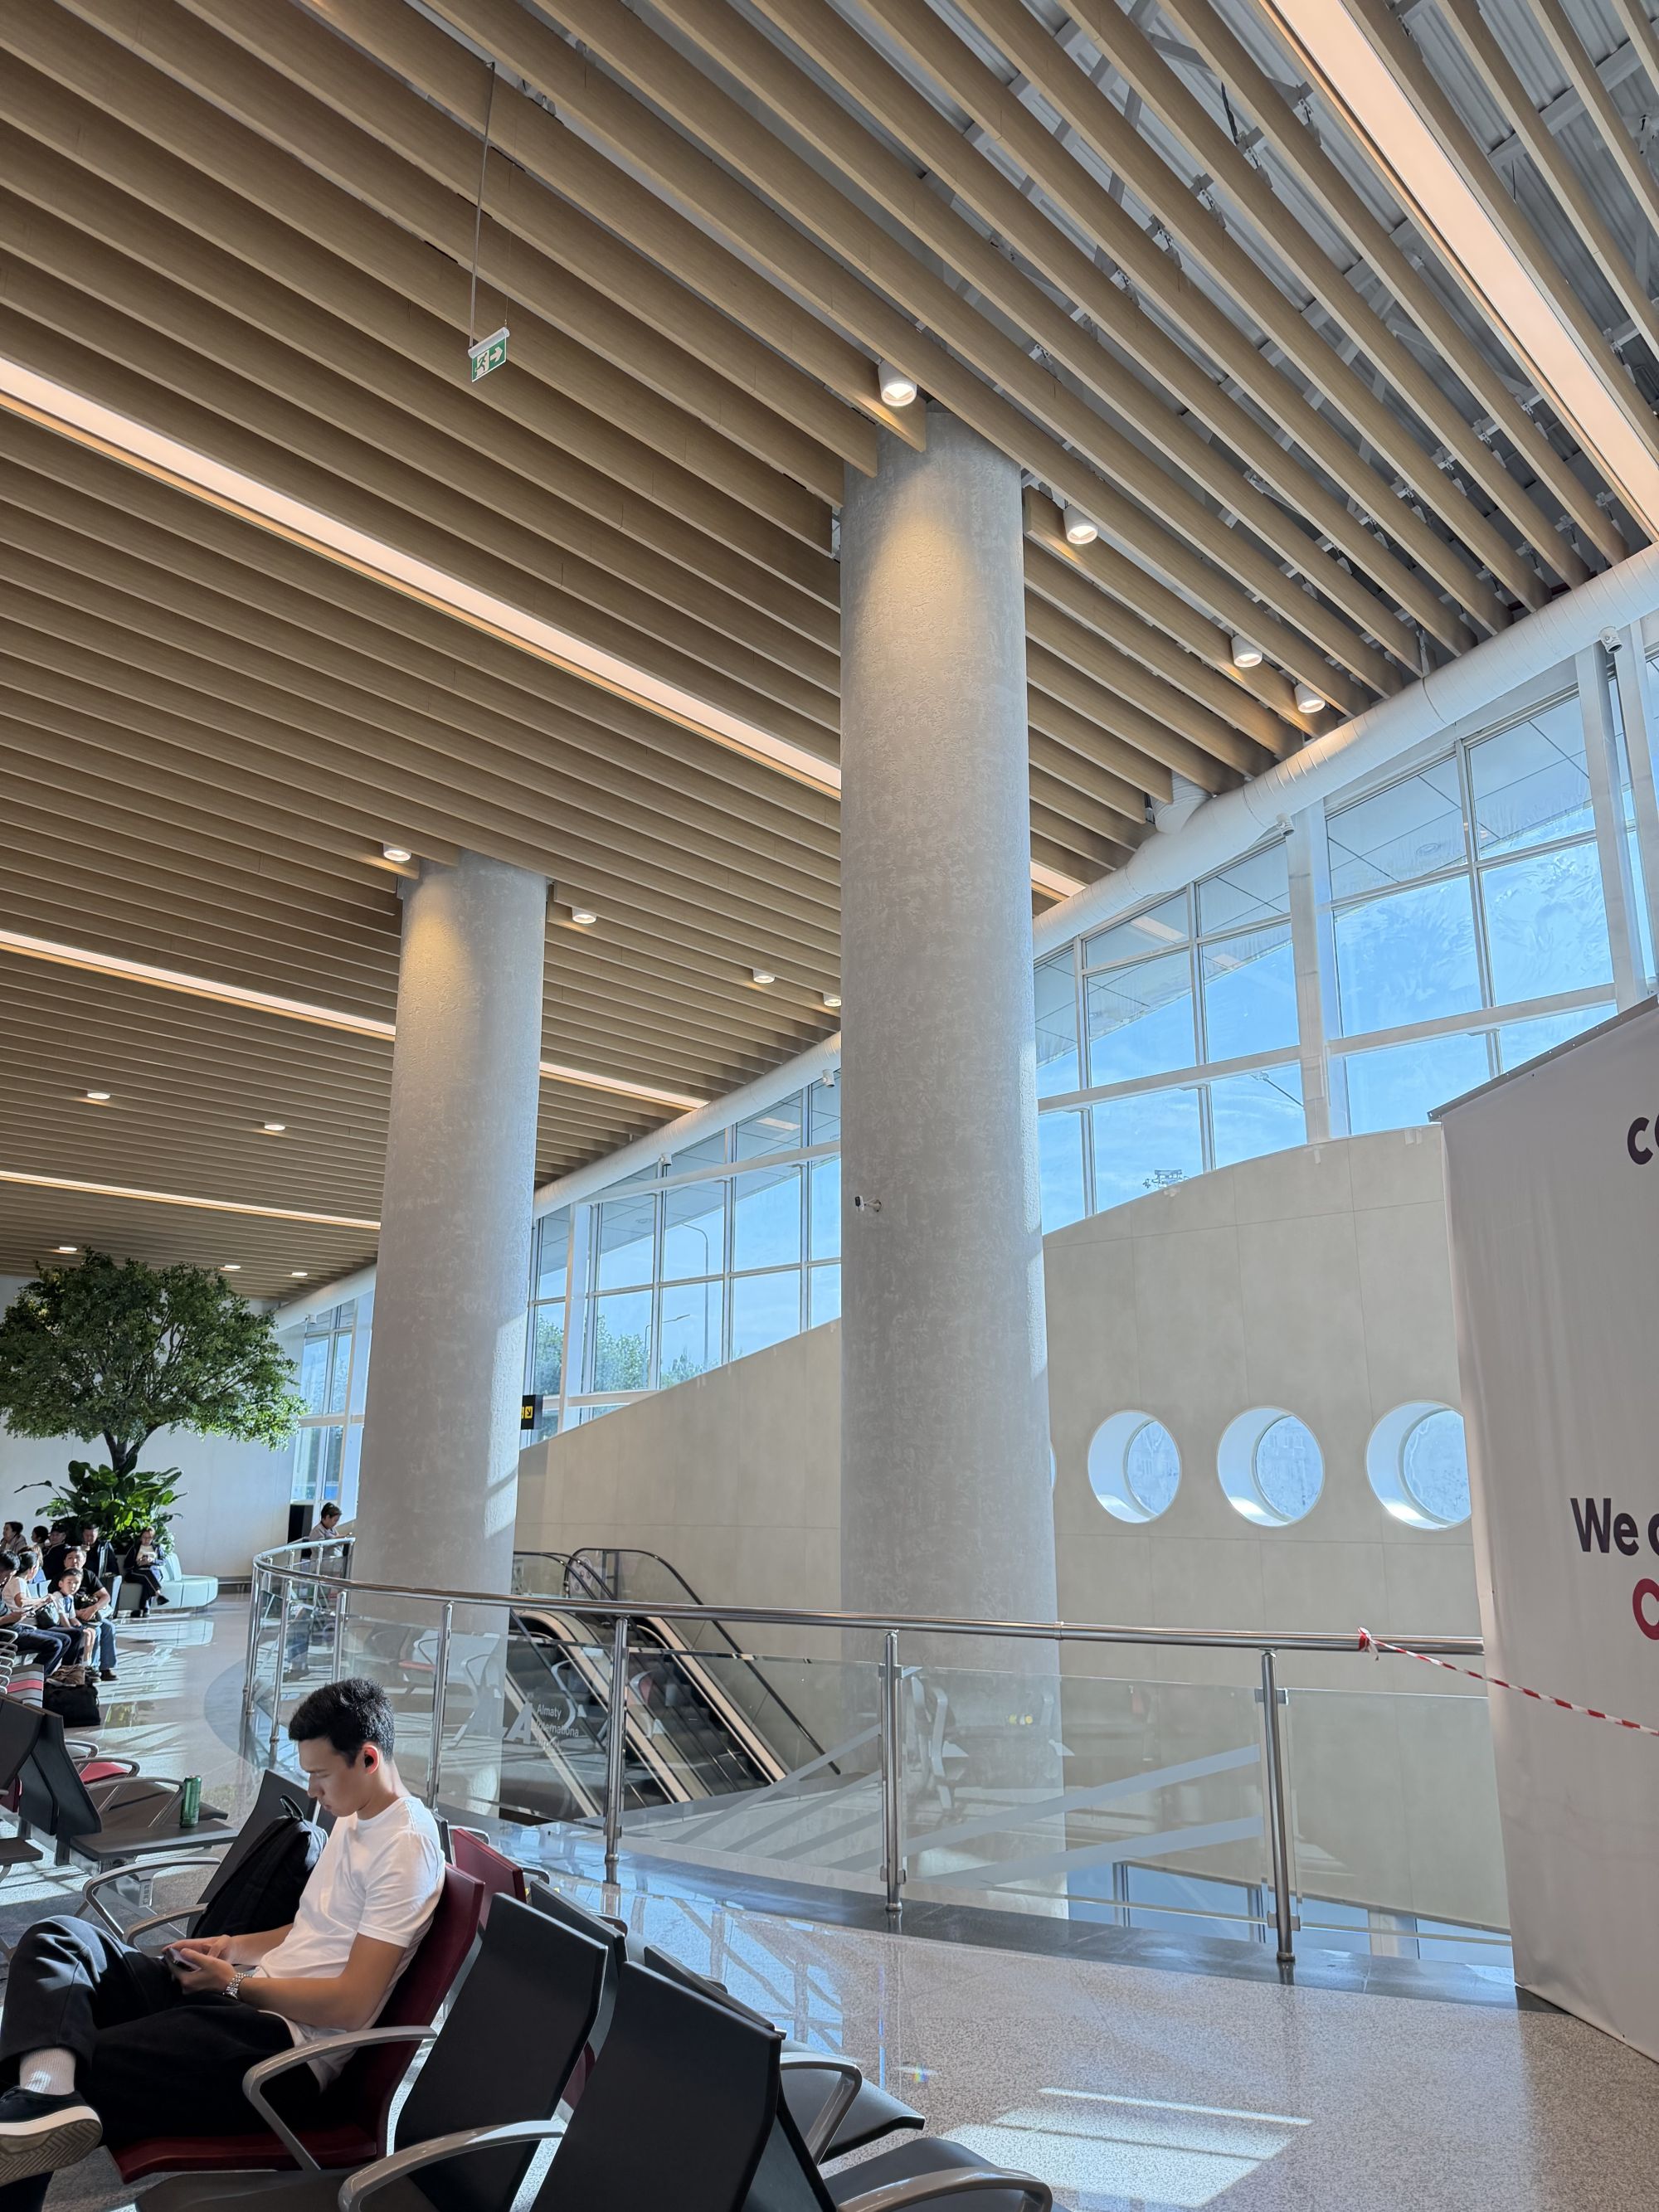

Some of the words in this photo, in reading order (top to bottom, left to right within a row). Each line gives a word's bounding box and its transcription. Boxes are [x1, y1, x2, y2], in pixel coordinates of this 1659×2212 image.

[1627, 1114, 1659, 1165] c
[1570, 1498, 1639, 1556] We
[537, 1704, 562, 1719] Almaty
